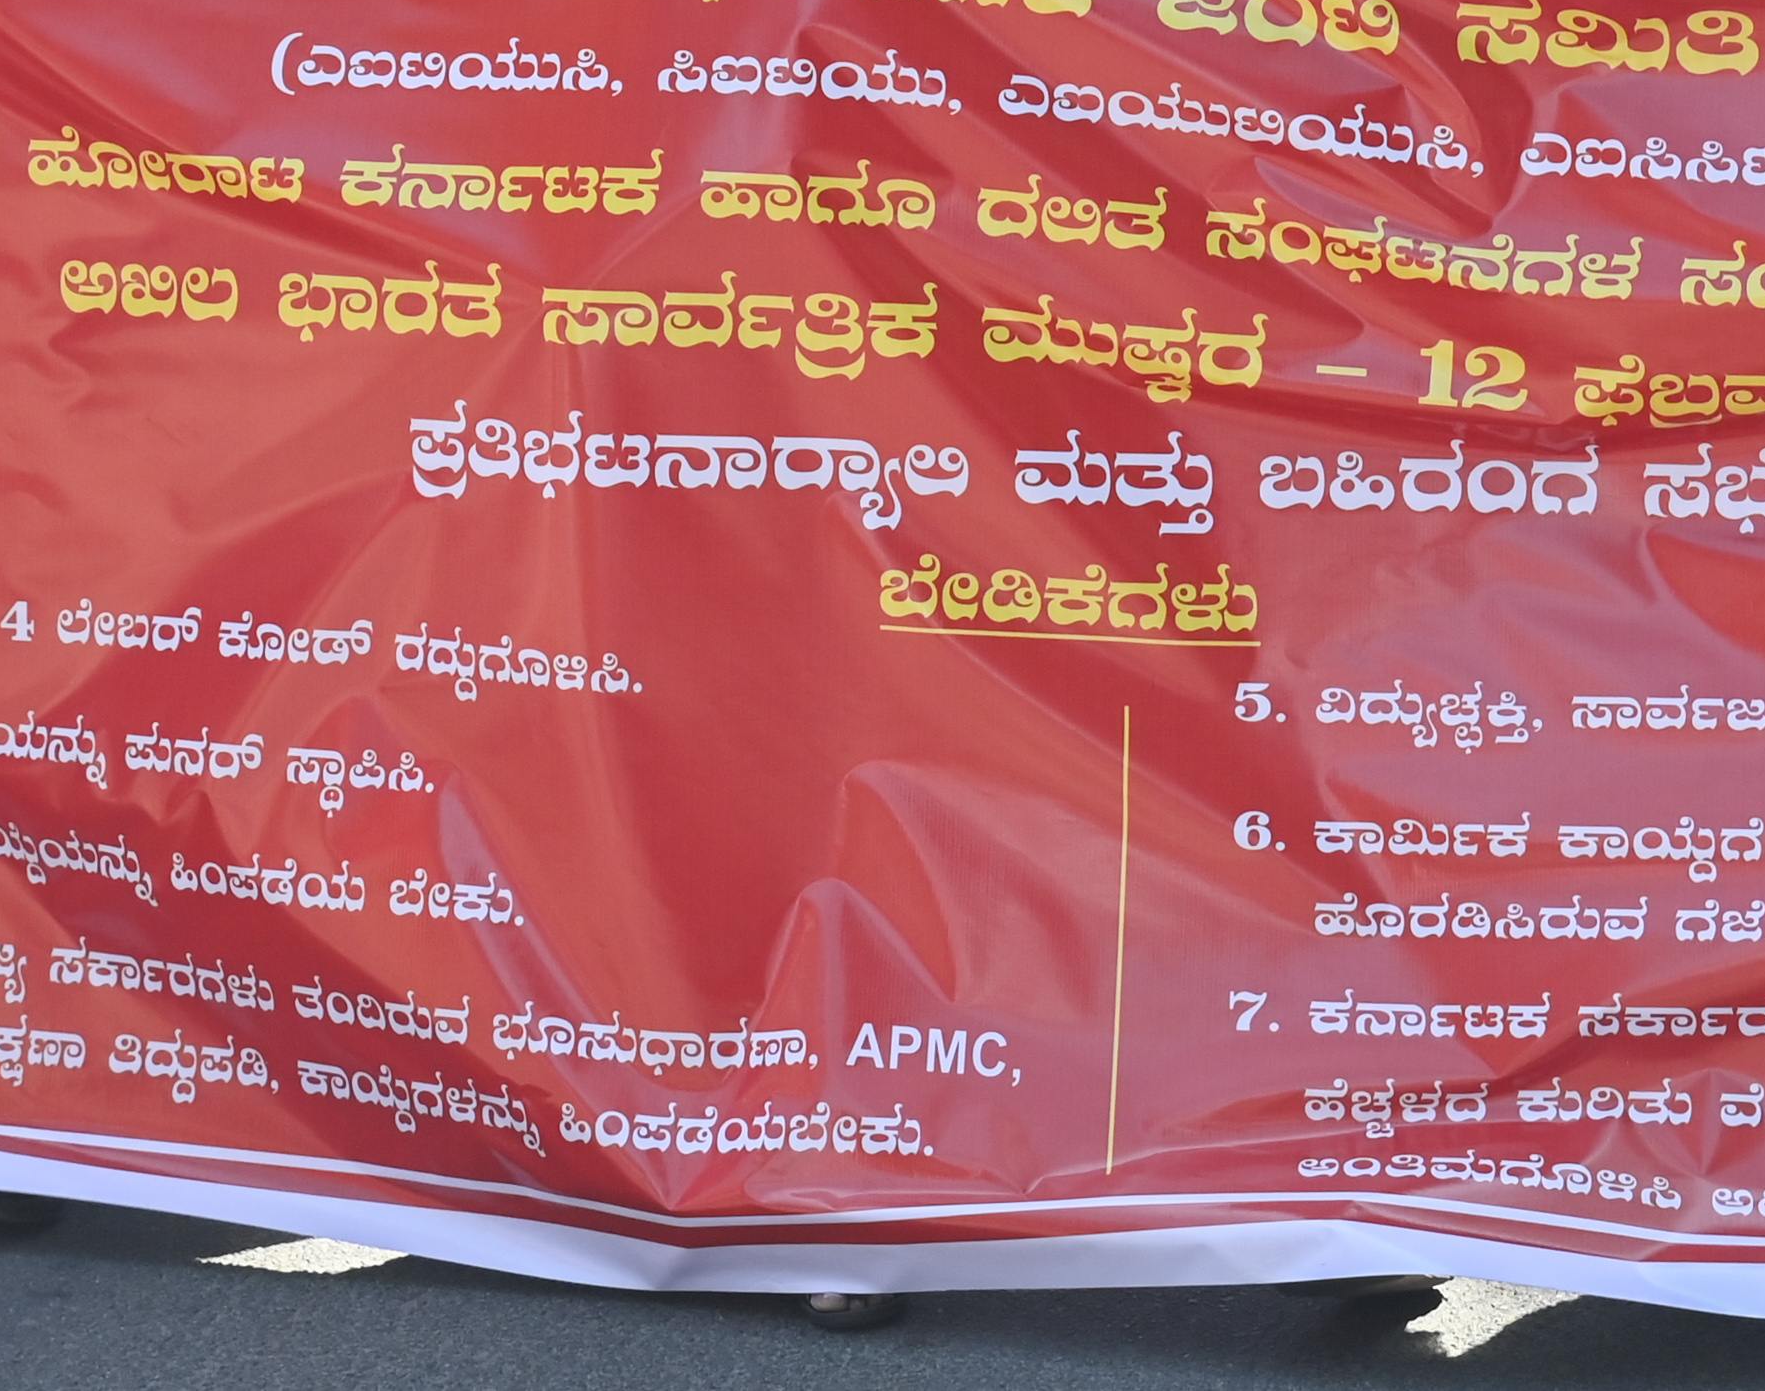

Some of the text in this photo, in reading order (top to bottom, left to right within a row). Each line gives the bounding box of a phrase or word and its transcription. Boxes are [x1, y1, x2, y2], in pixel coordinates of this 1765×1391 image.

[271, 32, 623, 97] (ಎಐಟಿಯುಸಿ,
[657, 48, 962, 116] ಸಿಐಟಿಯು,
[998, 74, 1485, 179] ಎಐಯುಟಿಯುಸಿ,
[27, 125, 305, 203] ಹೋರಾಟ
[339, 143, 664, 216] ಕರ್ನಾಟಕ
[699, 159, 936, 230] ಹಾಗೂ
[976, 174, 1168, 251] ದಲಿತ
[1205, 197, 1644, 301] ಸಂಘಟನೆಗಳ
[59, 259, 239, 322] ಅಖಿಲ
[278, 259, 502, 342] ಭಾರತ
[542, 270, 938, 381] ಸಾರ್ವತ್ರಿಕ
[982, 294, 1269, 403] ಮುಷ್ಕರ
[1417, 339, 1529, 411] 12
[1014, 429, 1215, 537] ಮತ್ತು
[1258, 438, 1601, 516] ಬಹಿರಂಗ
[879, 553, 1259, 632] ಬೇಡಿಕೆಗಳು
[0, 600, 35, 642] 4
[57, 597, 202, 652] ಲೇಬರ್
[217, 610, 374, 666] ಕೋಡ್
[394, 622, 644, 702] ರದ್ದುಗೊಳಿಸಿ.
[1234, 681, 1287, 724] 5.
[124, 721, 265, 780] ಪುನರ್
[286, 746, 435, 819] ಸ್ಥಾಪಿಸಿ.
[169, 851, 366, 912] ಹಿಂಪಡೆಯ
[388, 868, 525, 927] ಬೇಕು.
[1232, 810, 1287, 852] 6.
[1312, 811, 1531, 857] ಕಾರ್ಮಿಕ
[1557, 816, 1764, 883] ಕಾಯ್ದೆಗೆ
[1313, 892, 1649, 941] ಹೊರಡಿಸಿರುವ
[49, 935, 276, 1012] ಸರ್ಕಾರಗಳು
[291, 974, 471, 1046] ತಂದಿರುವ
[492, 999, 819, 1077] ಭೂಸುಧಾರಣಾ,
[845, 1022, 1022, 1088] APMC,
[1228, 989, 1280, 1033] 7.
[1308, 988, 1551, 1040] ಕರ್ನಾಟಕ
[108, 1028, 280, 1104] ತಿದ್ದುಪಡಿ,
[296, 1059, 547, 1158] ಕಾಯ್ದೆಗಳನ್ನು
[558, 1100, 935, 1157] ಹಿಂಪಡೆಯಬೇಕು.
[1304, 1077, 1489, 1139] ಹೆಚ್ಚಳದ
[1515, 1076, 1693, 1125] ಕುರಿತು
[1297, 1148, 1682, 1210] ಅಂತಿಮಗೊಳಿಸಿ
